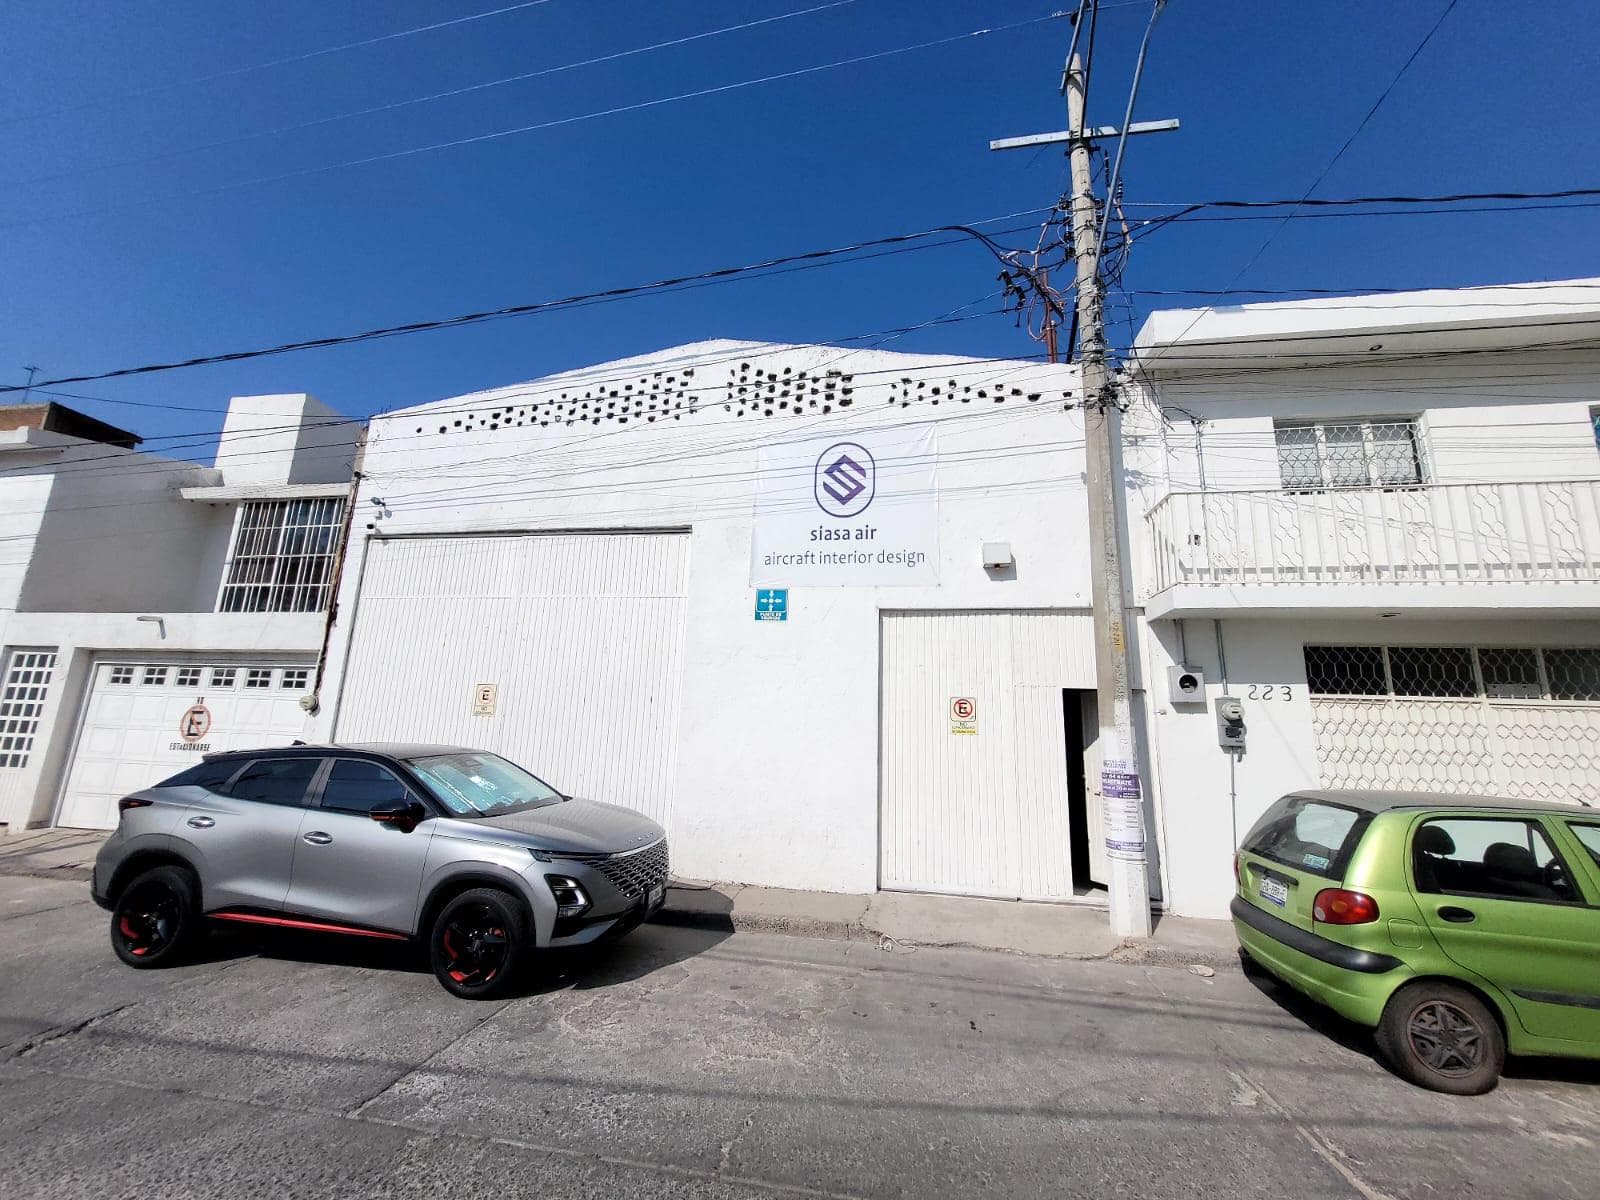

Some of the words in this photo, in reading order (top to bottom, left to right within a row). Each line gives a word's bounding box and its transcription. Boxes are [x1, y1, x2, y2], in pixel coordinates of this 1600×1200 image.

[810, 525, 850, 541] siasa
[855, 524, 877, 541] air
[764, 550, 816, 566] aircraft
[819, 550, 873, 565] interior
[877, 549, 925, 567] design
[958, 702, 967, 714] E
